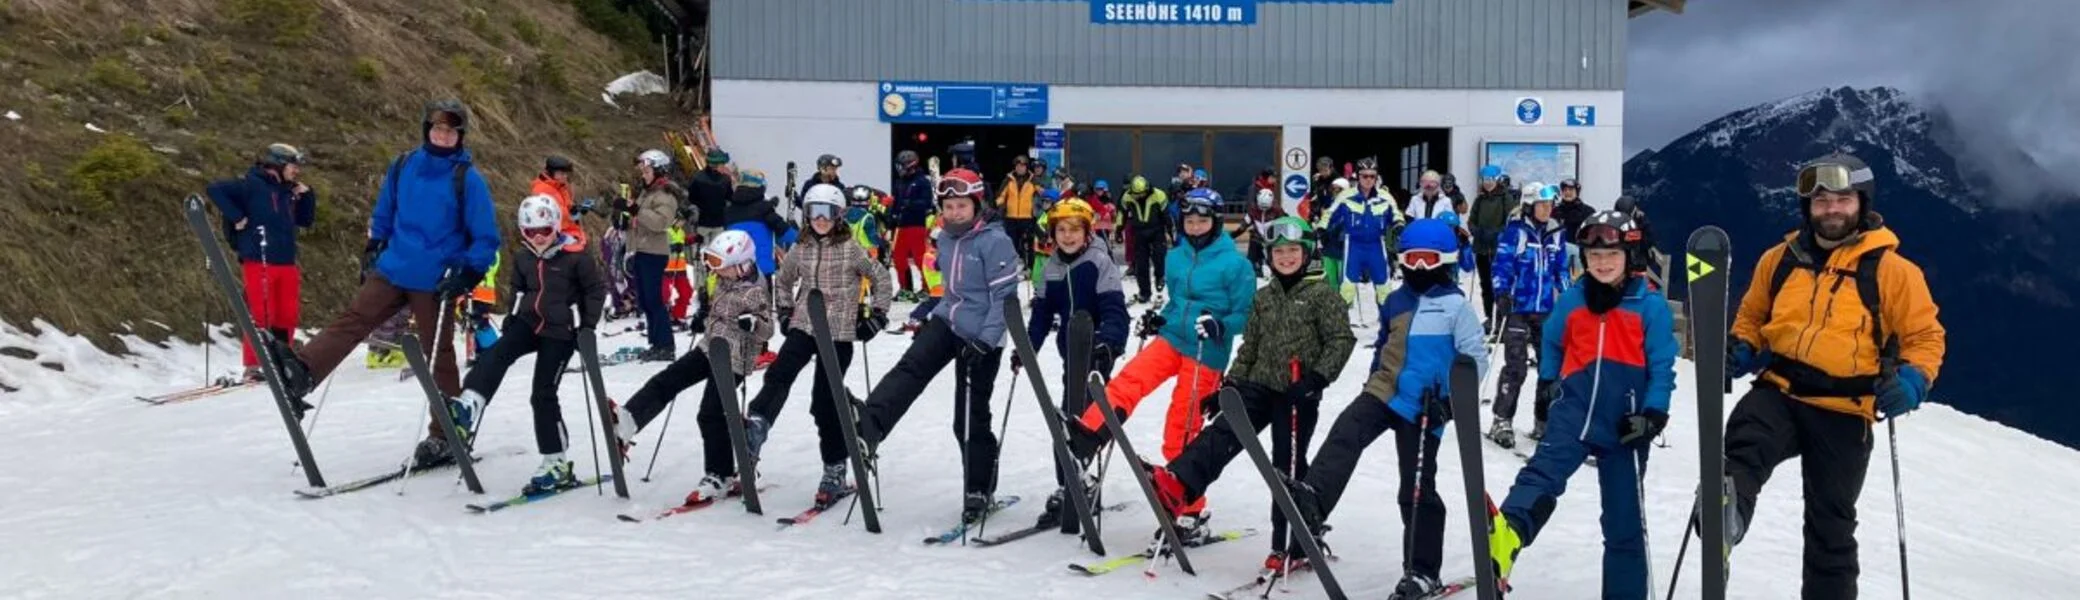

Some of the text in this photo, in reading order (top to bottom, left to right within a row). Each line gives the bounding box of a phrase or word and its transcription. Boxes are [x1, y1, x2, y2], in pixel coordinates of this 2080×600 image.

[1105, 2, 1242, 21] SEEHÖHE 1410 m
